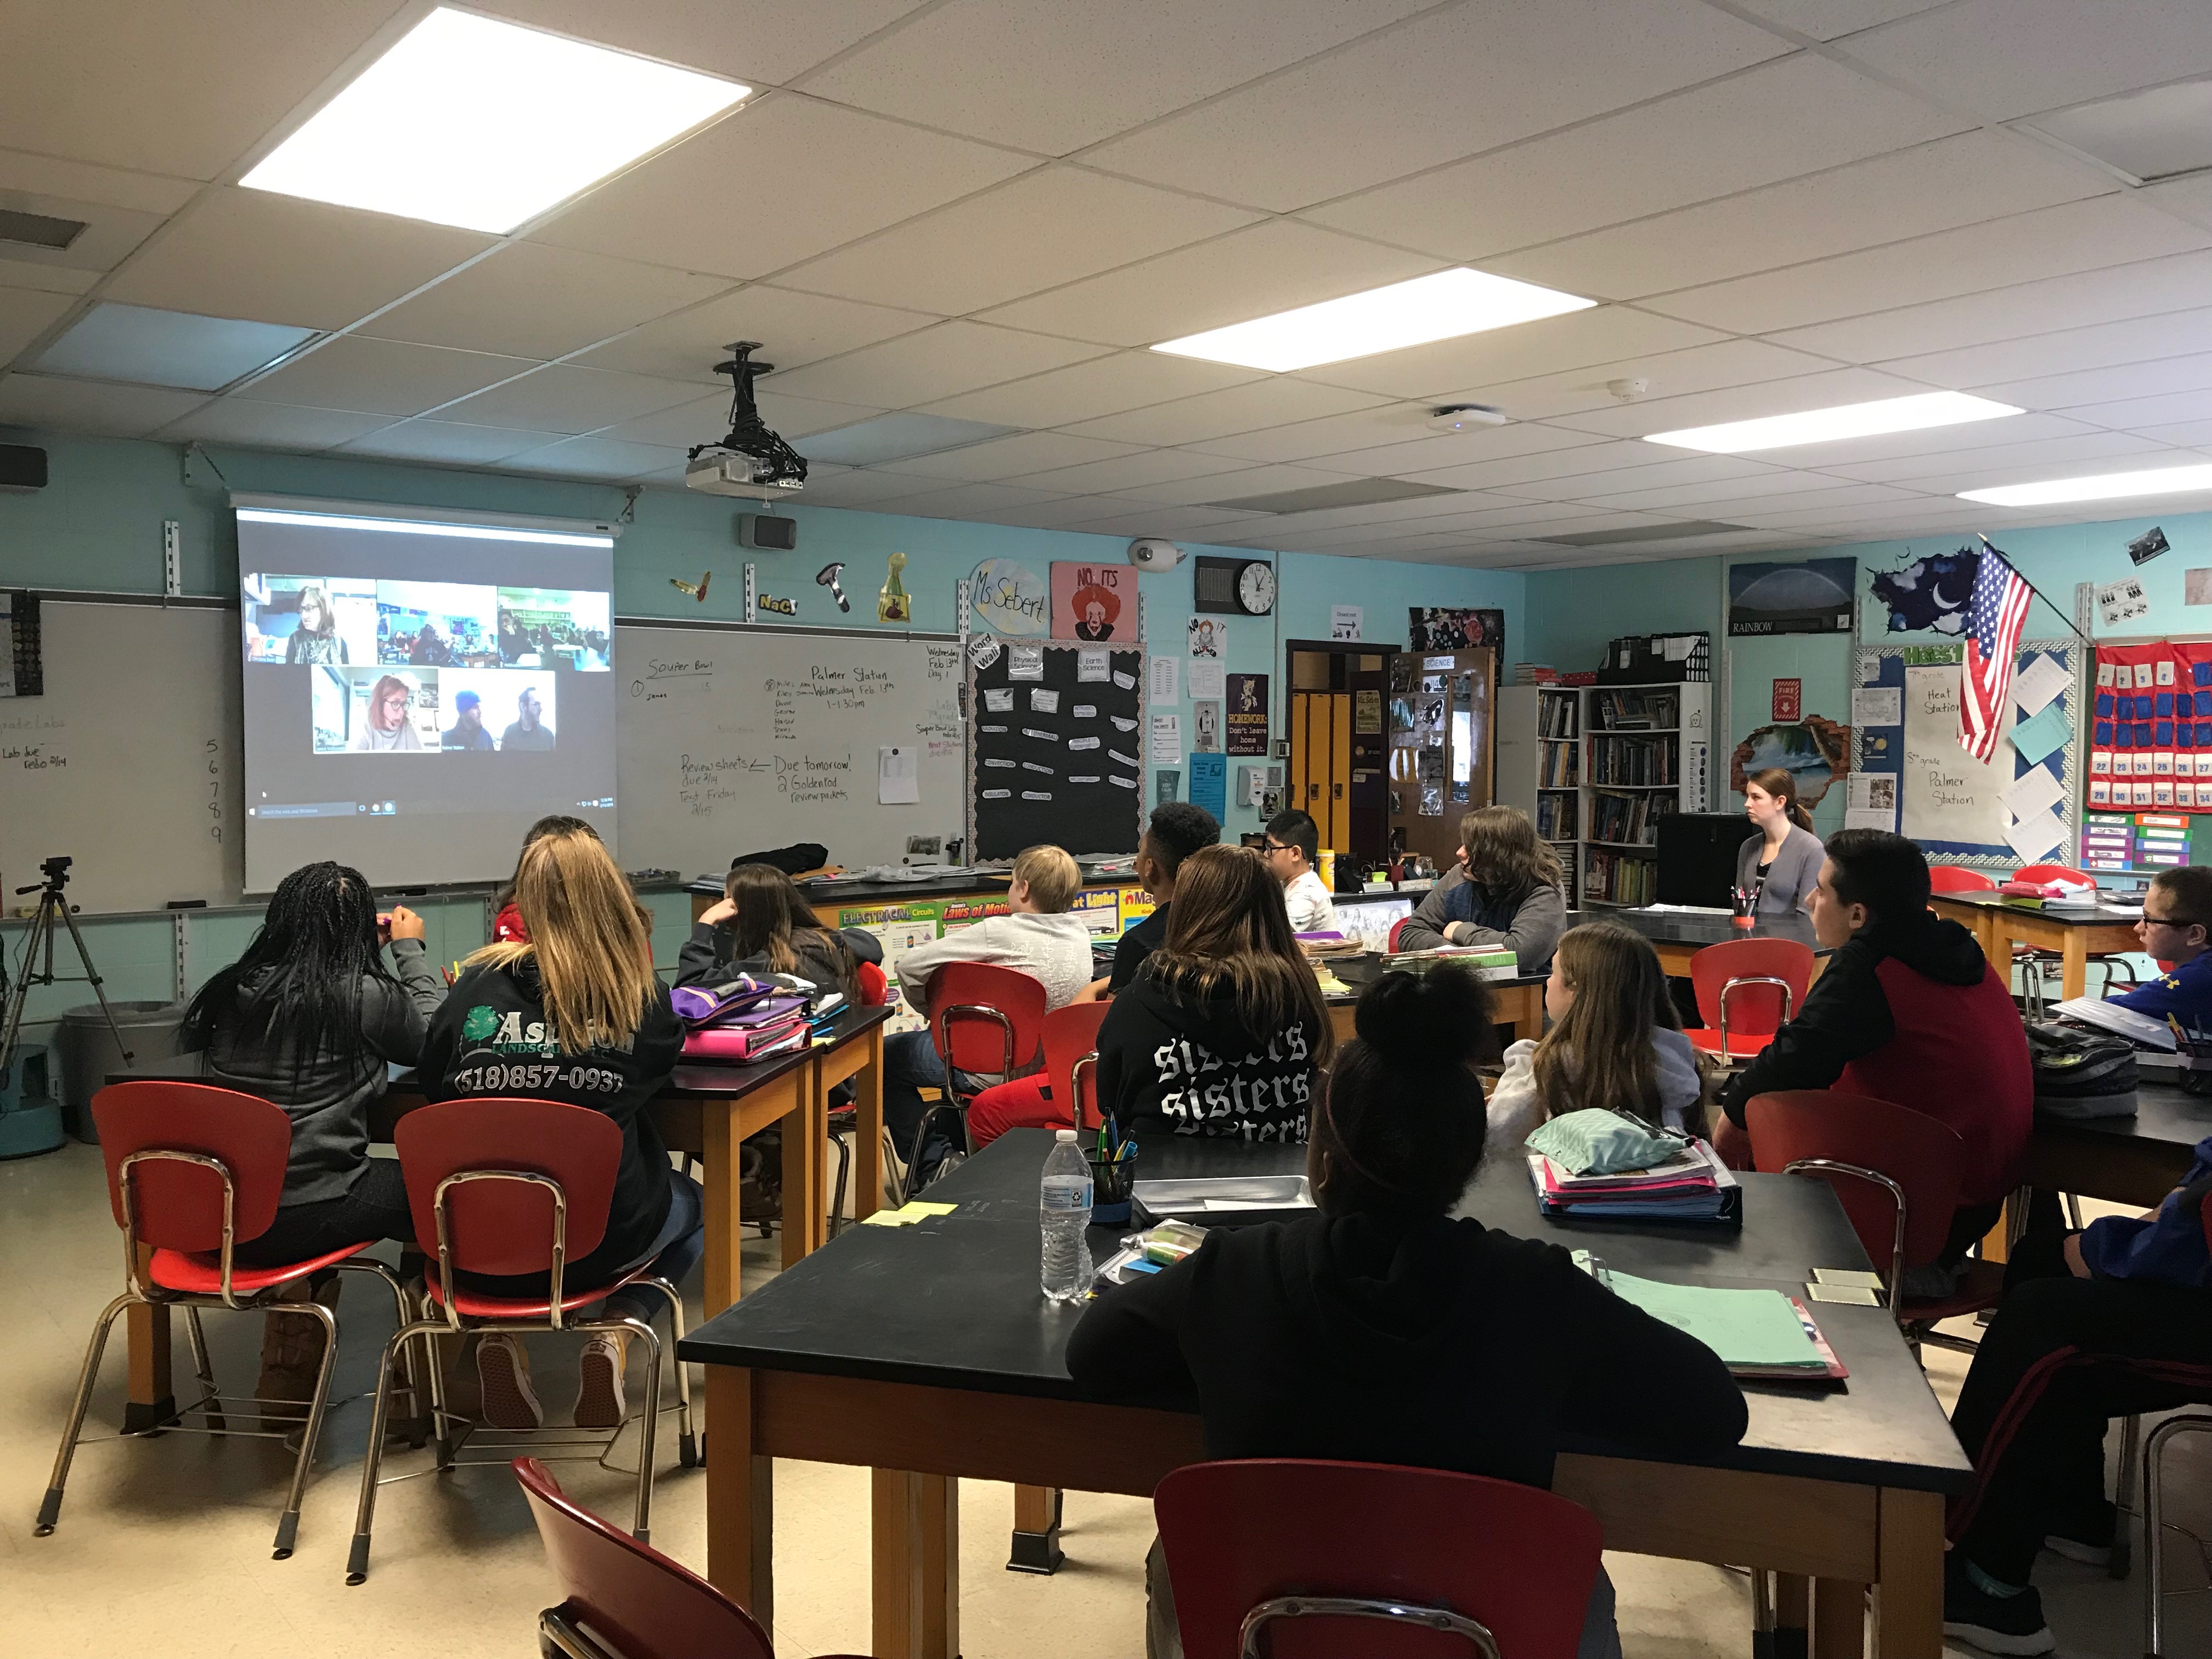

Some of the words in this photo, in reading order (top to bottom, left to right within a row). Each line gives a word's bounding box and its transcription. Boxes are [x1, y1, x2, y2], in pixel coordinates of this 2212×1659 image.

[1101, 569, 1118, 588] ITS
[994, 577, 1045, 623] Sebert
[1189, 618, 1199, 634] NO
[1216, 622, 1227, 633] IT
[1733, 622, 1773, 632] RAINBOW
[926, 645, 960, 659] Wednesday
[967, 633, 991, 657] Word
[695, 660, 713, 670] Bowl
[929, 657, 944, 668] Feb
[978, 647, 999, 667] Wall
[811, 665, 846, 681] Palmer
[853, 668, 887, 682] Station
[928, 669, 942, 681] Day
[1922, 671, 1945, 683] grade
[812, 683, 855, 699] Wednesday
[1927, 687, 1952, 701] Heat
[936, 698, 956, 710] Labs
[1228, 714, 1267, 724] HOMEWORK:
[3, 747, 20, 758] Lab
[24, 746, 40, 757] due
[206, 739, 218, 753] 5
[208, 760, 218, 774] 6
[681, 754, 713, 774] Review
[715, 755, 748, 770] sheets
[773, 755, 799, 775] Due
[805, 754, 852, 772] tomorrow!
[1023, 763, 1052, 774] CONDUCTION
[1920, 758, 1940, 768] grade
[2199, 764, 2209, 772] 27
[682, 774, 701, 787] due
[778, 775, 787, 793] 2
[1928, 771, 1968, 787] Palmer
[210, 781, 218, 797] 7
[680, 791, 698, 804] Test
[707, 787, 736, 801] Friday
[791, 792, 819, 803] review
[821, 789, 849, 803] packets
[1932, 791, 1974, 807] Station
[208, 802, 221, 819] 8
[691, 802, 713, 817] 2/15
[211, 826, 221, 843] 9
[1086, 891, 1116, 909] Light
[843, 908, 911, 924] ELECTRICAL
[912, 908, 934, 916] Circuits
[943, 906, 971, 921] Laws
[971, 904, 984, 918] of
[454, 1063, 624, 1094] (518)857-0937
[1161, 1068, 1310, 1120] sisters
